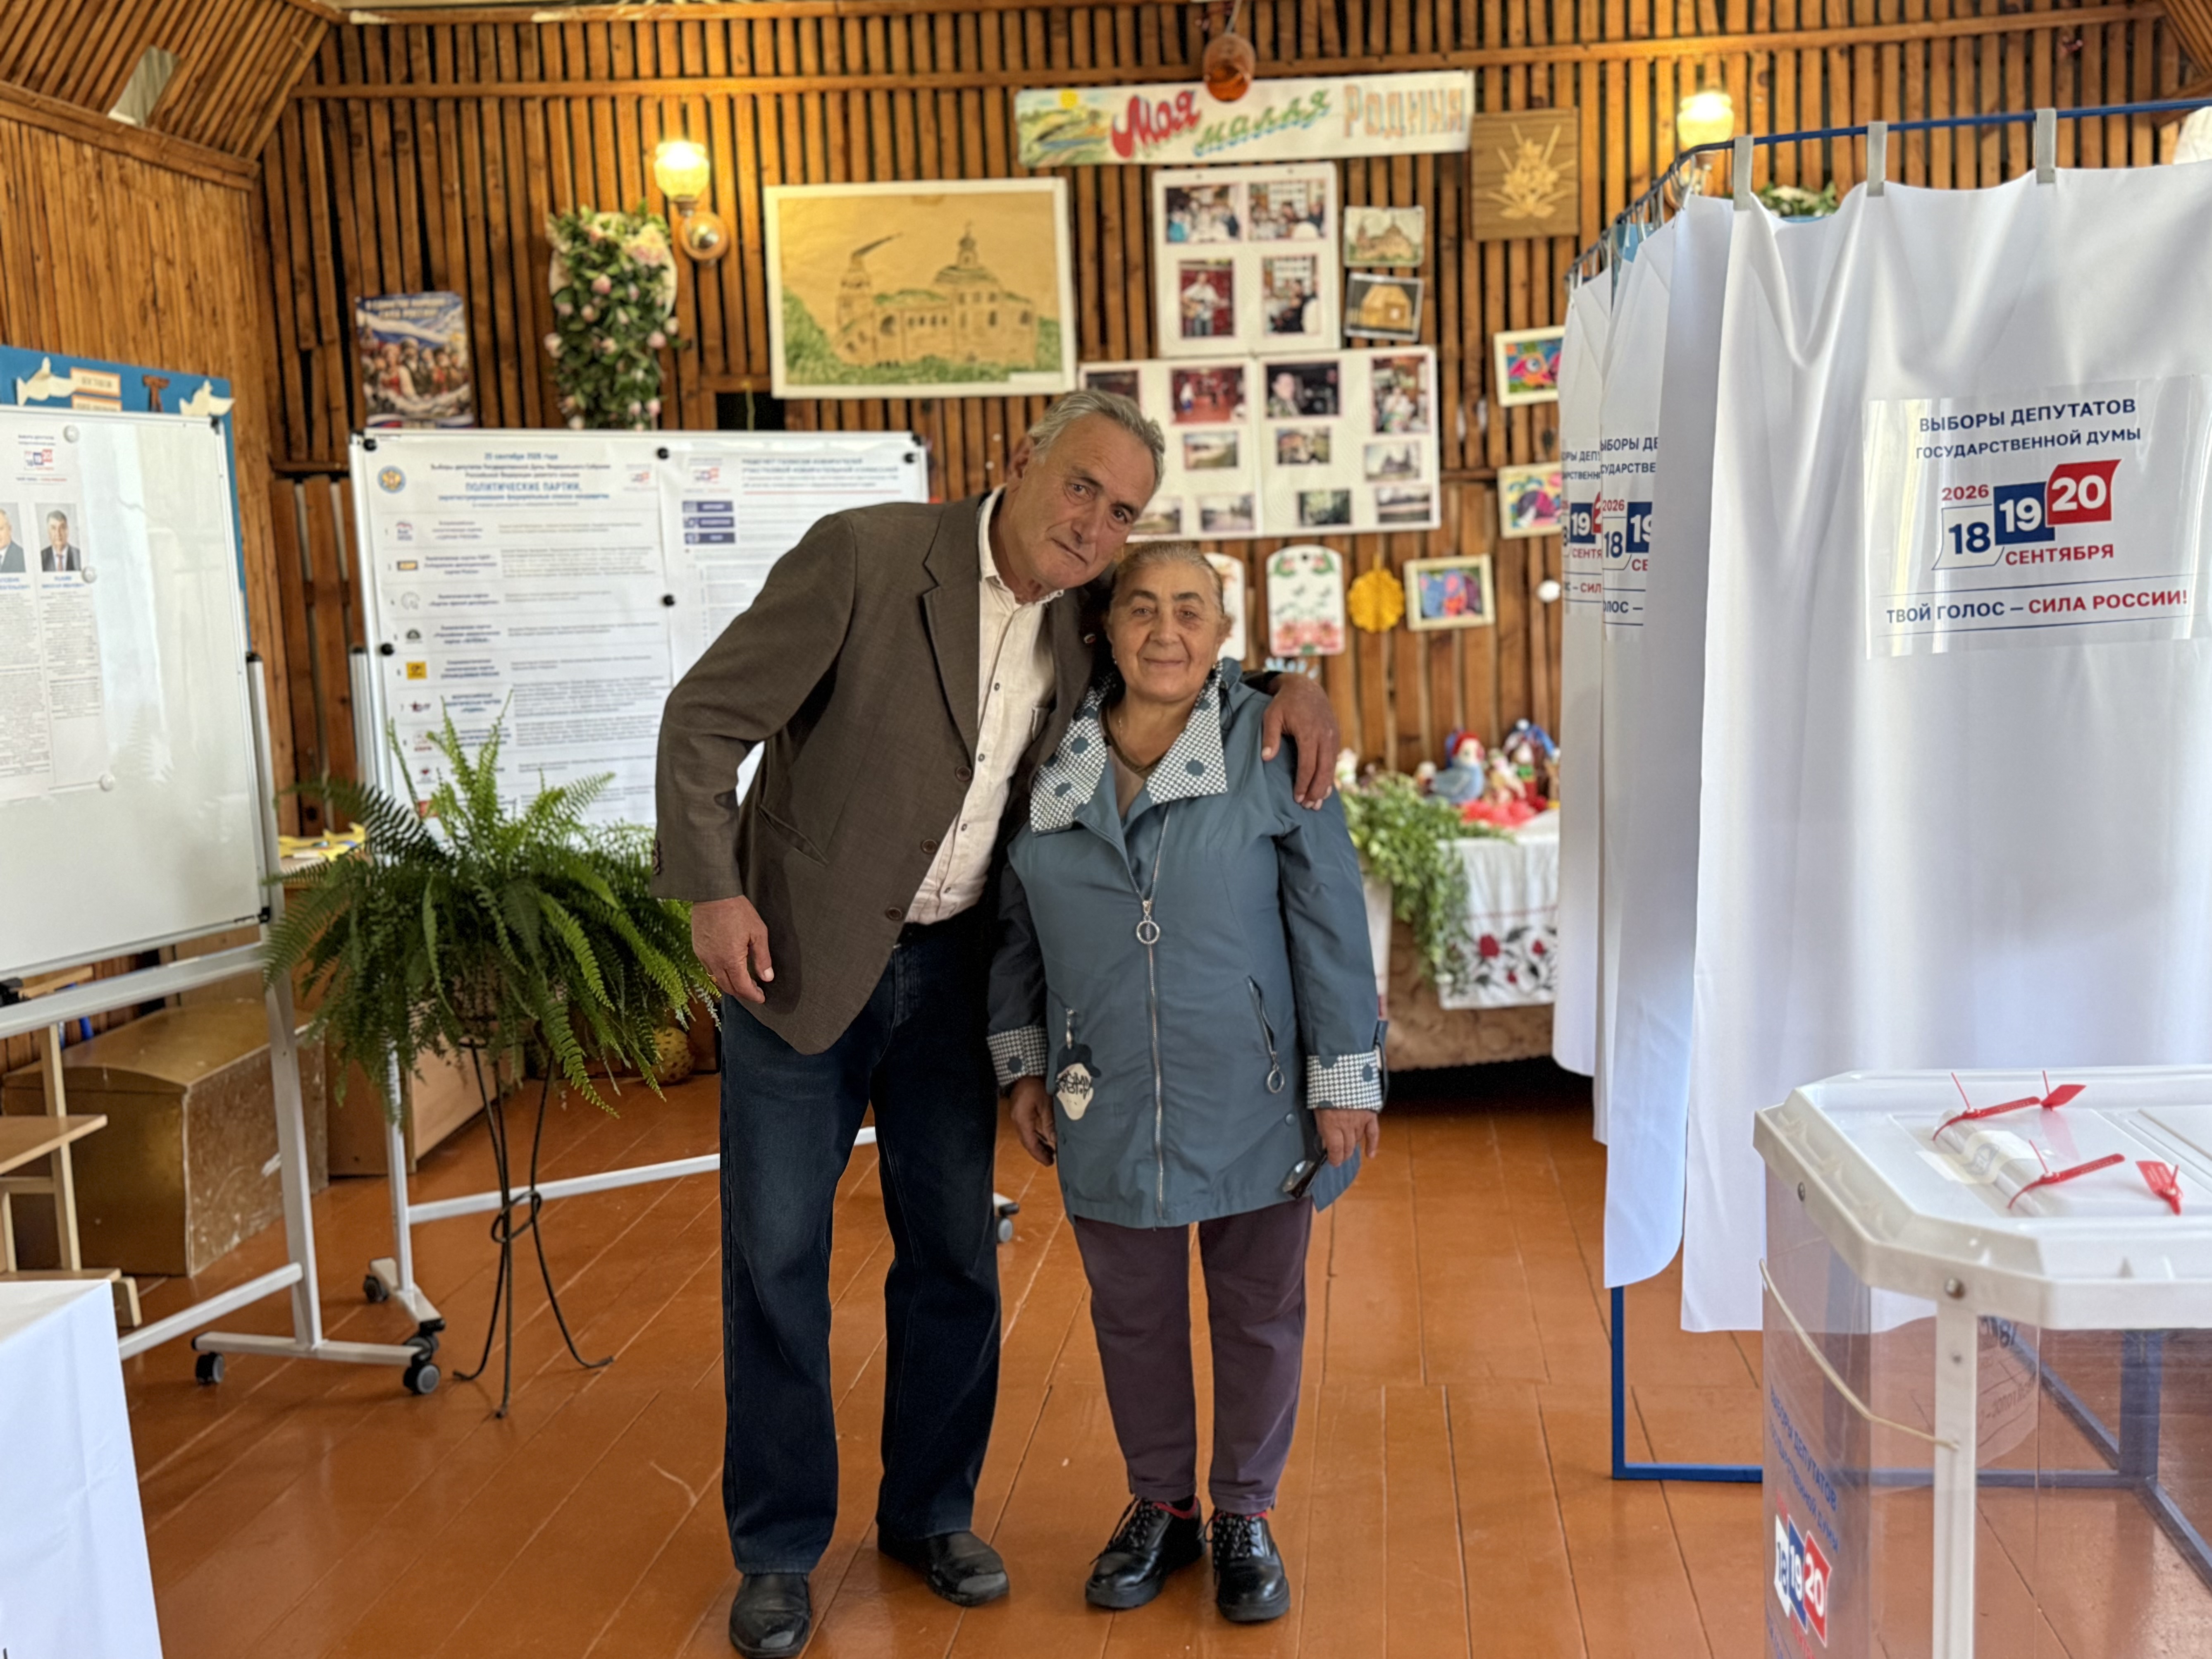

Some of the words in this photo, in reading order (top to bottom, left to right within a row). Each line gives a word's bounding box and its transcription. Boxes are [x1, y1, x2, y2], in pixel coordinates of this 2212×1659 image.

[1111, 89, 1202, 158] Моя
[1919, 411, 2005, 432] ВЫБОРЫ
[2010, 399, 2136, 427] ДЕПУТАТОВ
[1916, 430, 2081, 459] ГОСУДАРСТВЕННОЙ
[2086, 427, 2140, 446] ДУМЫ
[1602, 499, 1625, 512] 2026
[1942, 484, 1989, 501] 2026
[2051, 475, 2107, 512] 20
[1571, 511, 1590, 536] 19
[1999, 497, 2042, 533] 19
[1604, 531, 1623, 559] 18
[1948, 521, 1991, 555] 18
[2005, 544, 2114, 566] СЕНТЯБРЯ
[1886, 603, 1931, 623] ТВОЙ
[1937, 602, 2005, 620] ГОЛОС
[2028, 596, 2087, 614] СИЛА
[2093, 589, 2187, 610] РОССИИ!
[1790, 1544, 1803, 1601] 19
[1805, 1552, 1824, 1617] 20
